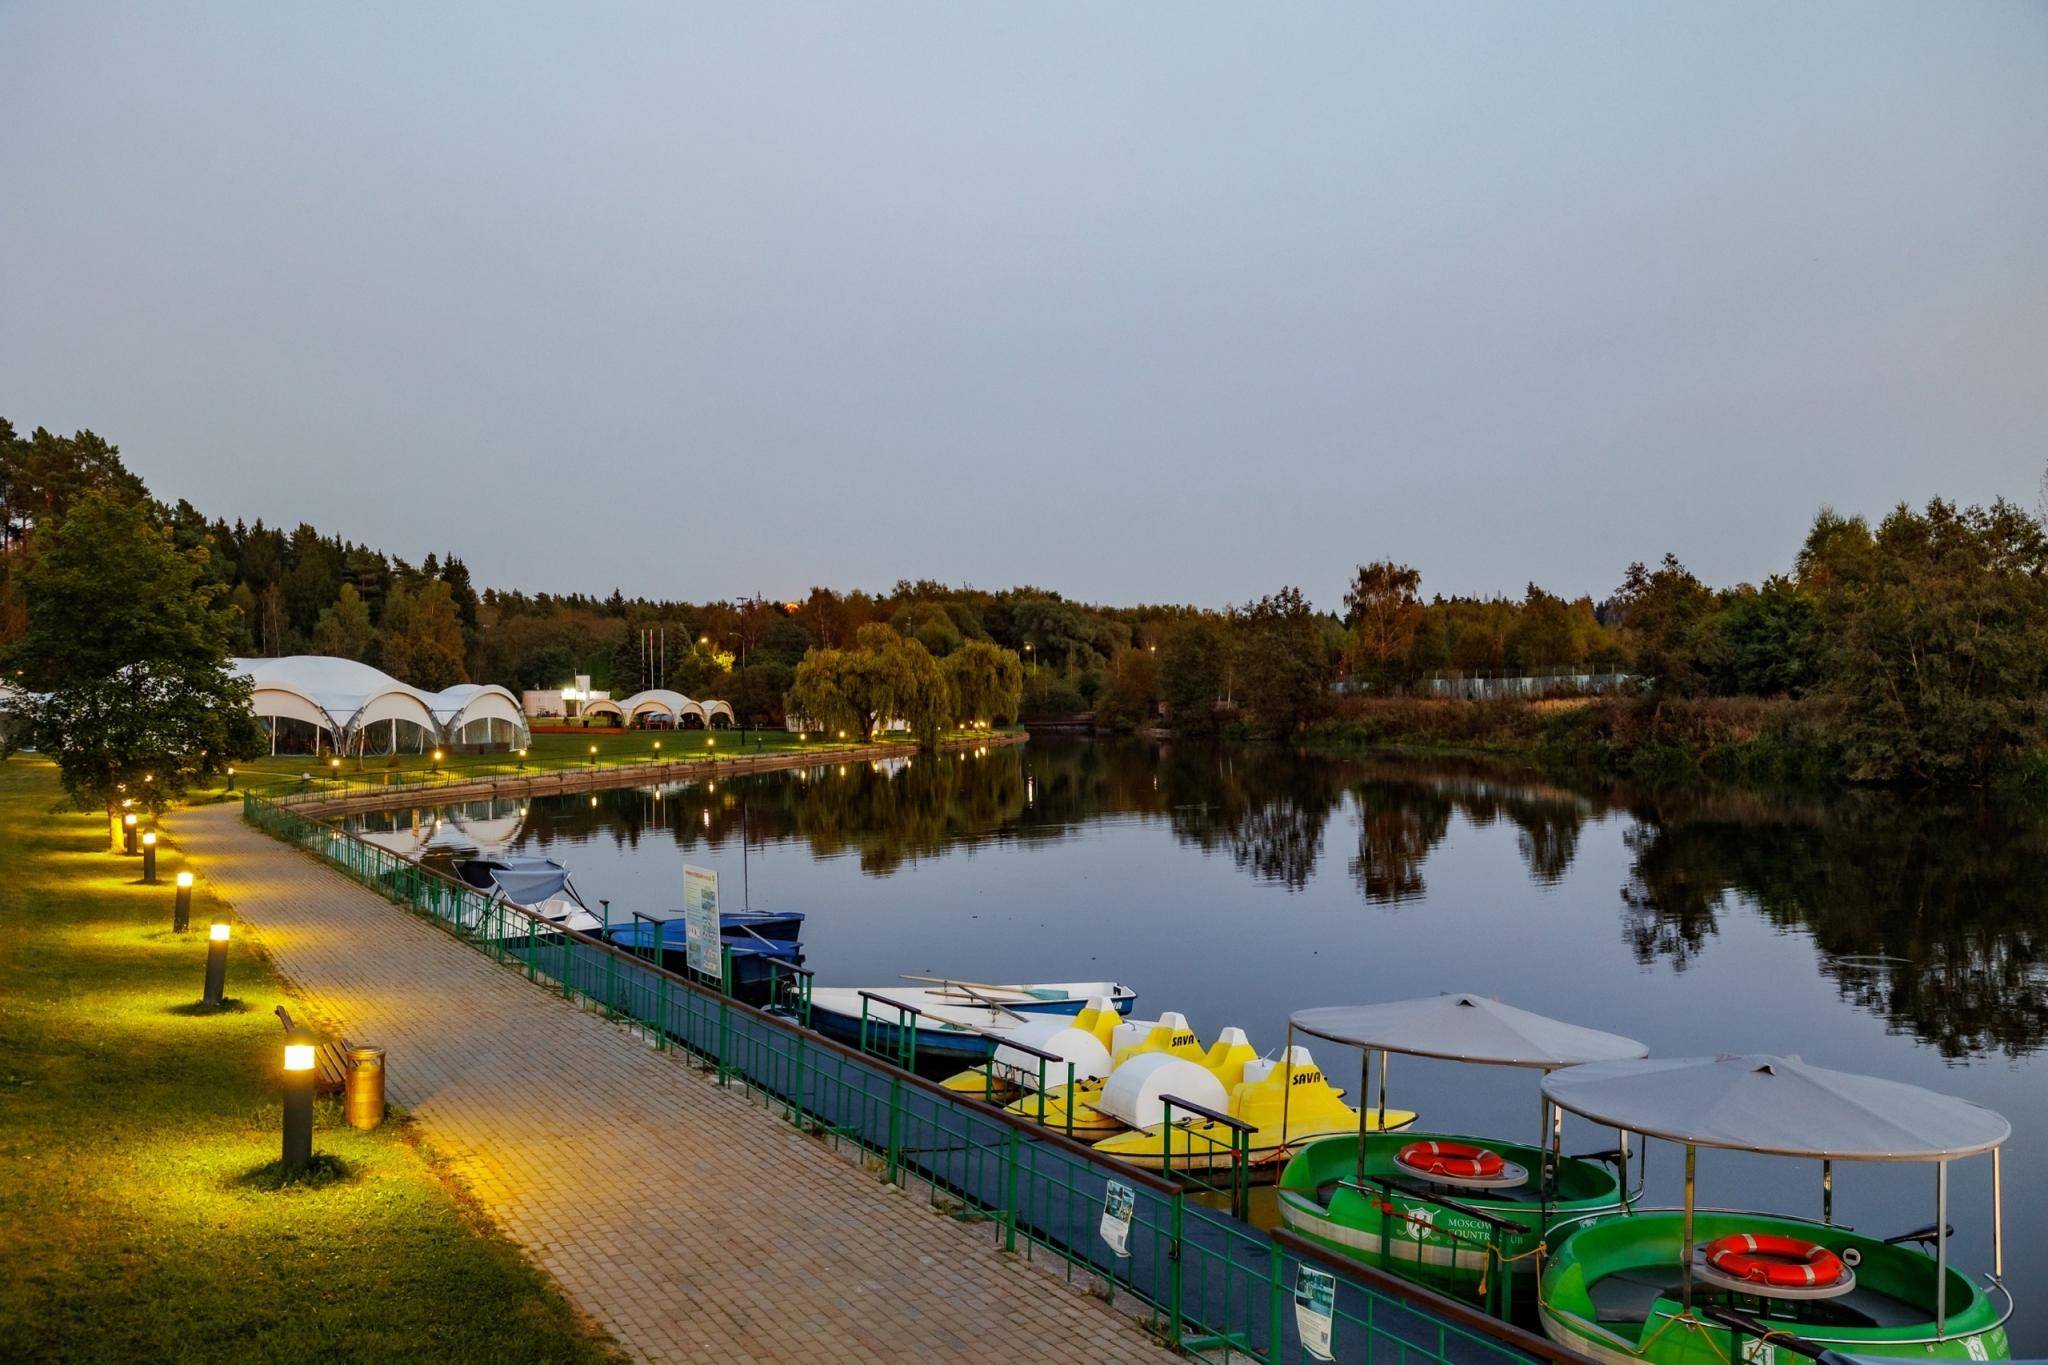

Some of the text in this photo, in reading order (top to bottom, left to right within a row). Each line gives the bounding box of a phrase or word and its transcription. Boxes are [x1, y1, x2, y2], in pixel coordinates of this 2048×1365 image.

[1171, 1034, 1195, 1047] SAVA
[1292, 1071, 1321, 1085] SAVA
[1448, 1229, 1491, 1241] OUNTR
